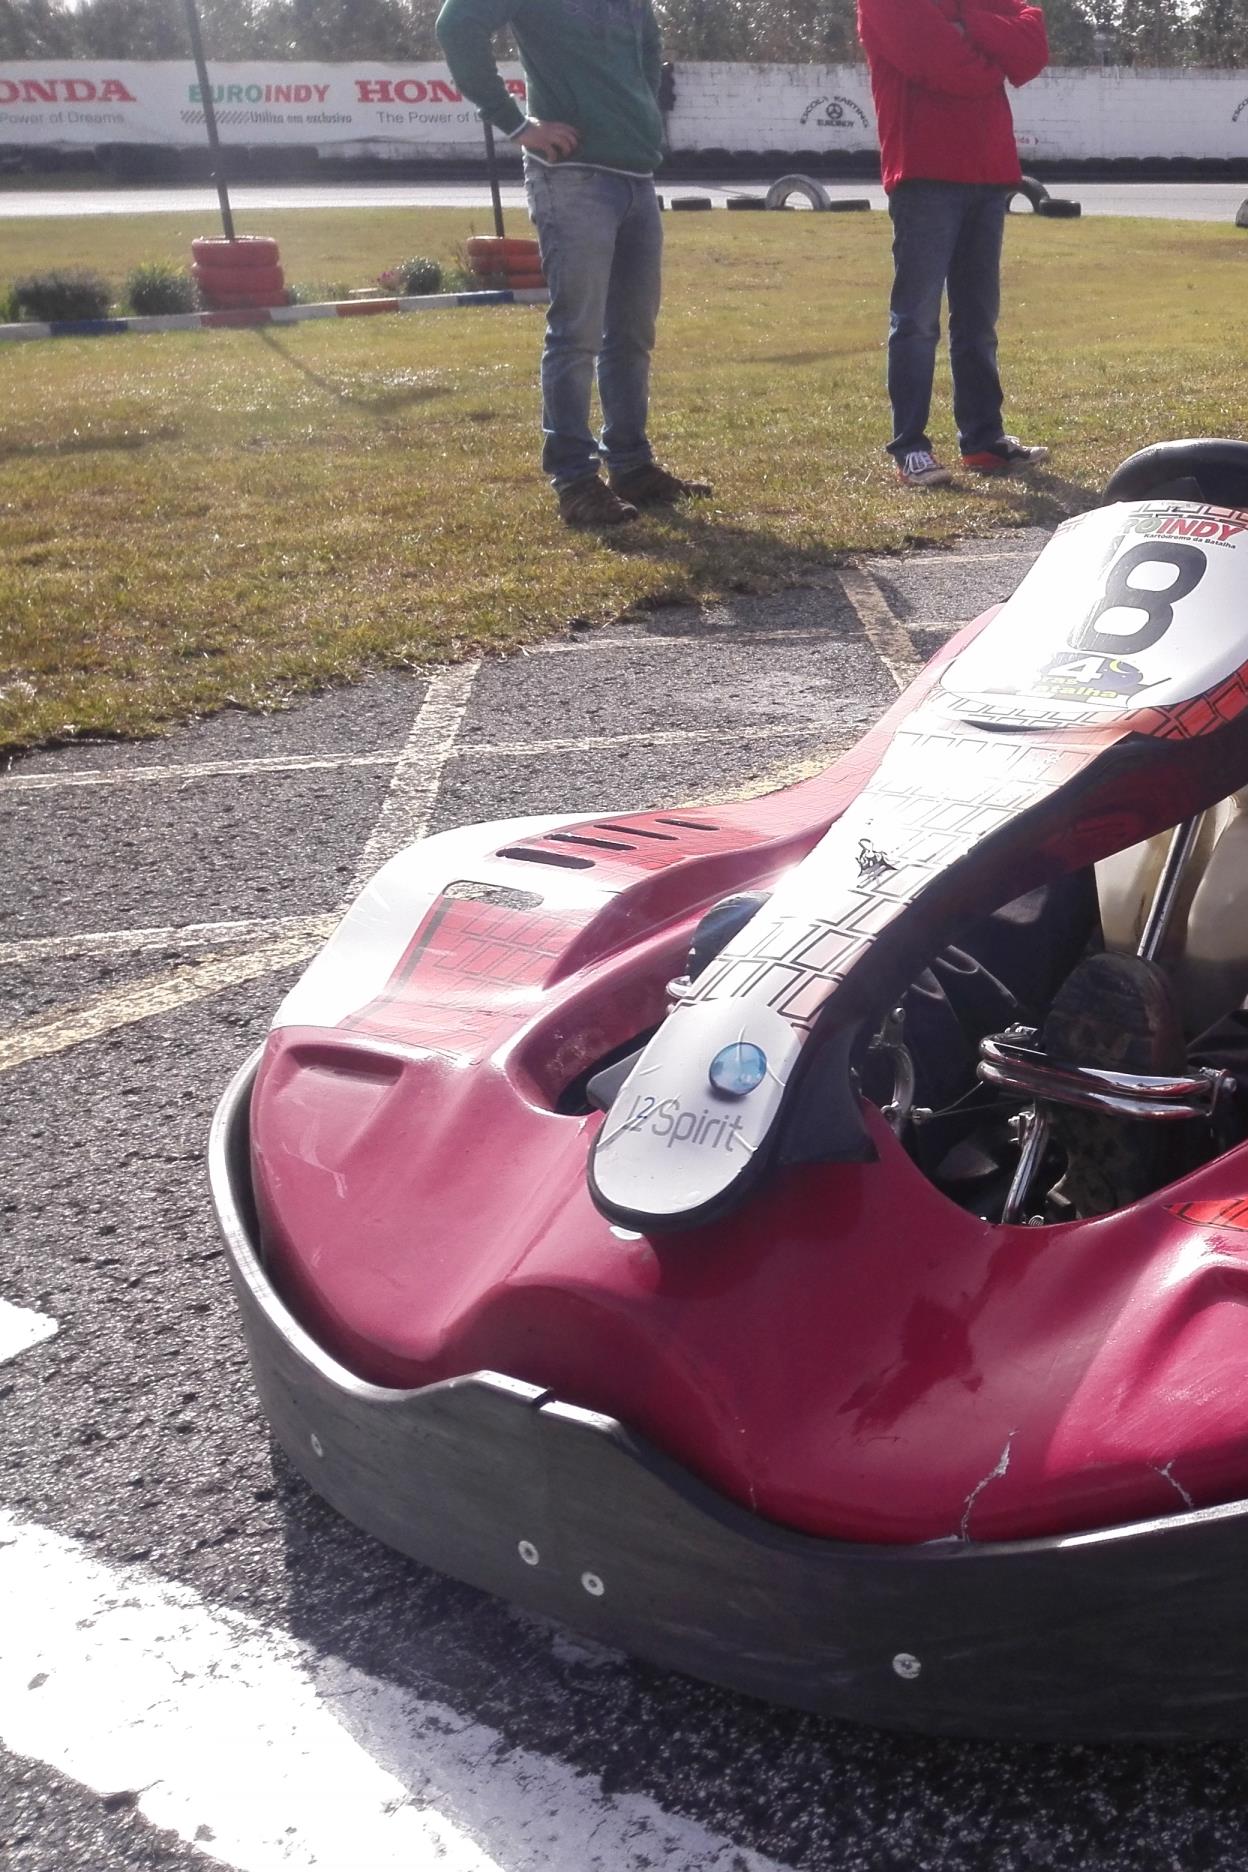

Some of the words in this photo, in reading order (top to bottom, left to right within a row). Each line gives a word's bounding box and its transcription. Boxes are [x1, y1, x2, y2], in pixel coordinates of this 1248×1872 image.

[188, 83, 330, 104] EUROINDY
[68, 111, 125, 123] Dreams
[378, 111, 404, 123] The
[408, 111, 451, 123] Power
[456, 110, 469, 123] of
[1192, 535, 1204, 543] da
